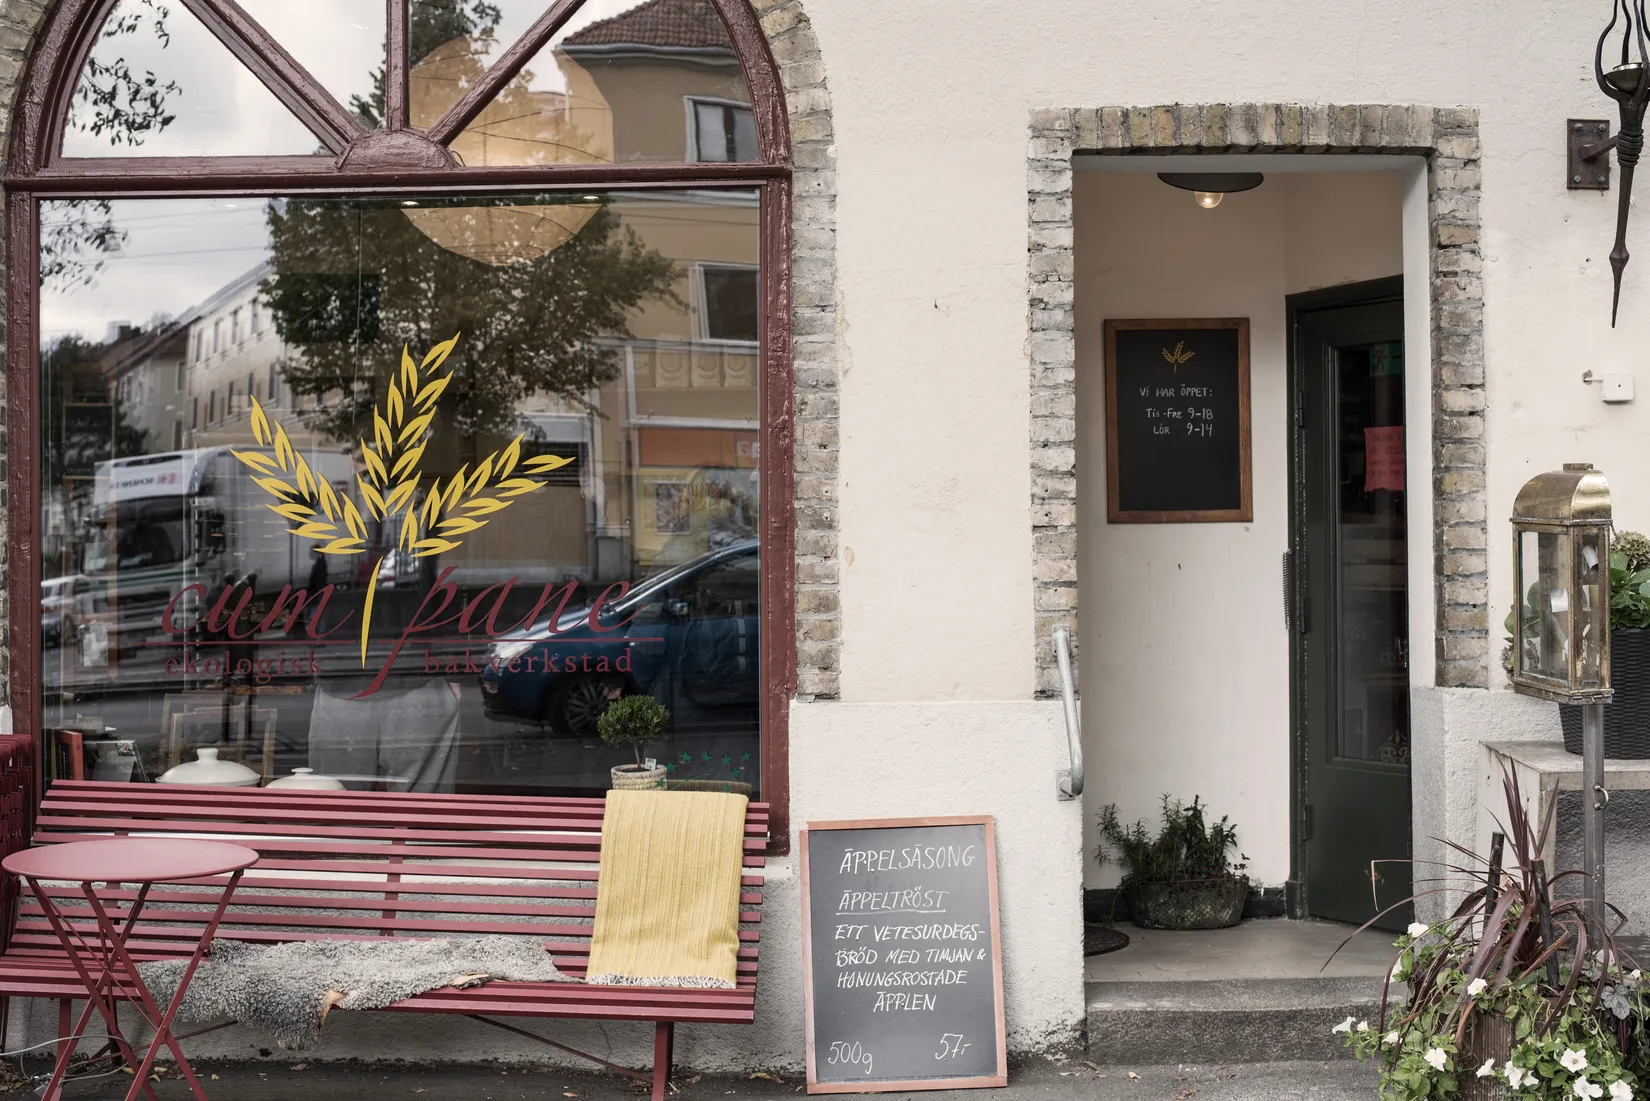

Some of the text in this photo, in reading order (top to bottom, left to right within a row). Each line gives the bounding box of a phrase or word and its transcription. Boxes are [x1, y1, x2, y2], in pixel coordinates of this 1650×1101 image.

[1156, 388, 1175, 397] HAR
[1180, 383, 1213, 397] ÖPPET:
[1187, 407, 1214, 420] 9-18
[1186, 422, 1213, 437] 9-14
[161, 565, 648, 701] cum pane
[164, 648, 633, 684] ekologisk bakverkstad
[835, 923, 986, 942] ETT VETESURDEGS-
[835, 946, 987, 967] BRÖD MED TIMJAN &
[837, 969, 969, 988] HONUNGSROSTADE
[827, 1041, 873, 1075] 500g
